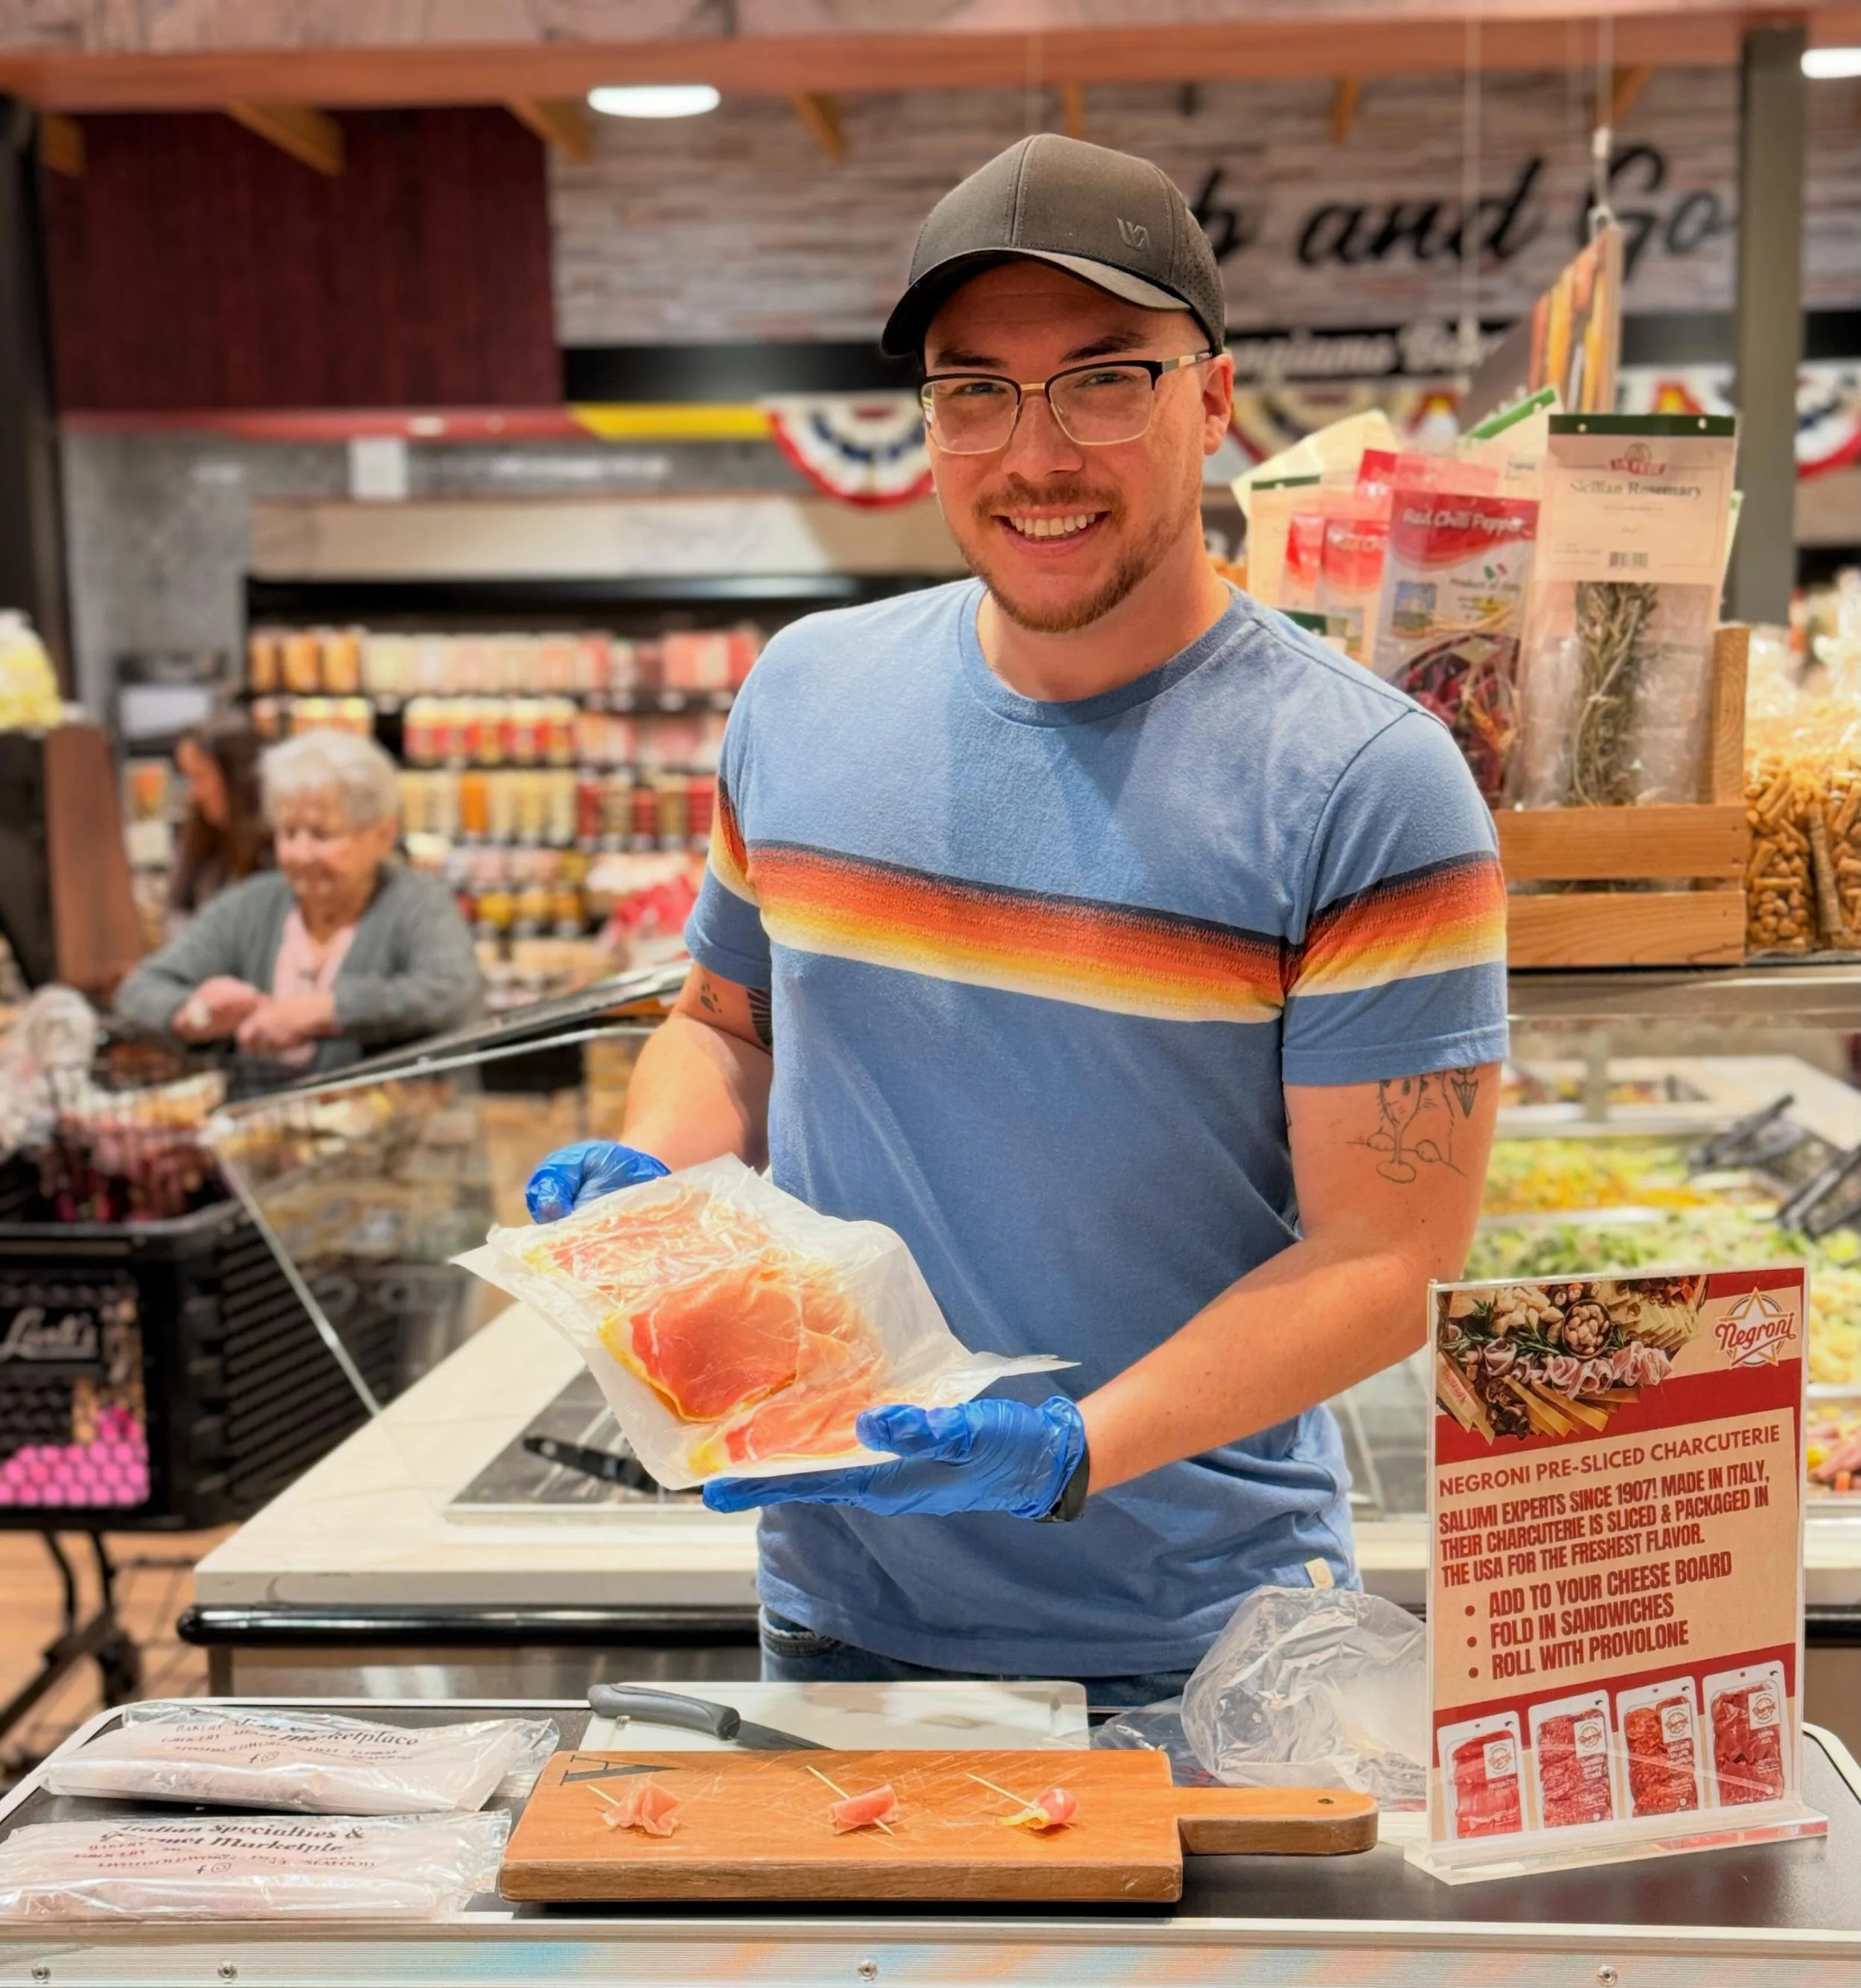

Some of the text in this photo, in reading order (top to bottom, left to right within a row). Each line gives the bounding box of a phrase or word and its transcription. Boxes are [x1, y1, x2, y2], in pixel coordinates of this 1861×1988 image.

[1297, 158, 1544, 266] and
[1570, 480, 1703, 500] Sicilian Rosemary
[1714, 1312, 1797, 1355] Negroni
[1439, 1424, 1780, 1497] NEGRONI PRE-SLICED CHARCUTERIE
[1439, 1459, 1769, 1535] SALUMI EXPERTS SINCE 1907! MADE IN ITALY,
[1440, 1485, 1769, 1561] THEIR CHARCUTERIE IS SLICED & PACKAGED IN
[1441, 1522, 1705, 1587] THE USA FOR THE FRESHEST FLAVOR.
[1489, 1550, 1732, 1618] ADD TO YOUR CHEESE BOARD
[1490, 1592, 1675, 1649] FOLD IN SANDWICHES
[1492, 1619, 1689, 1680] ROLL WITH PROVOLONE
[208, 1823, 337, 1839] Specialties
[344, 1826, 365, 1840] &
[209, 1837, 345, 1853] Marketpl
